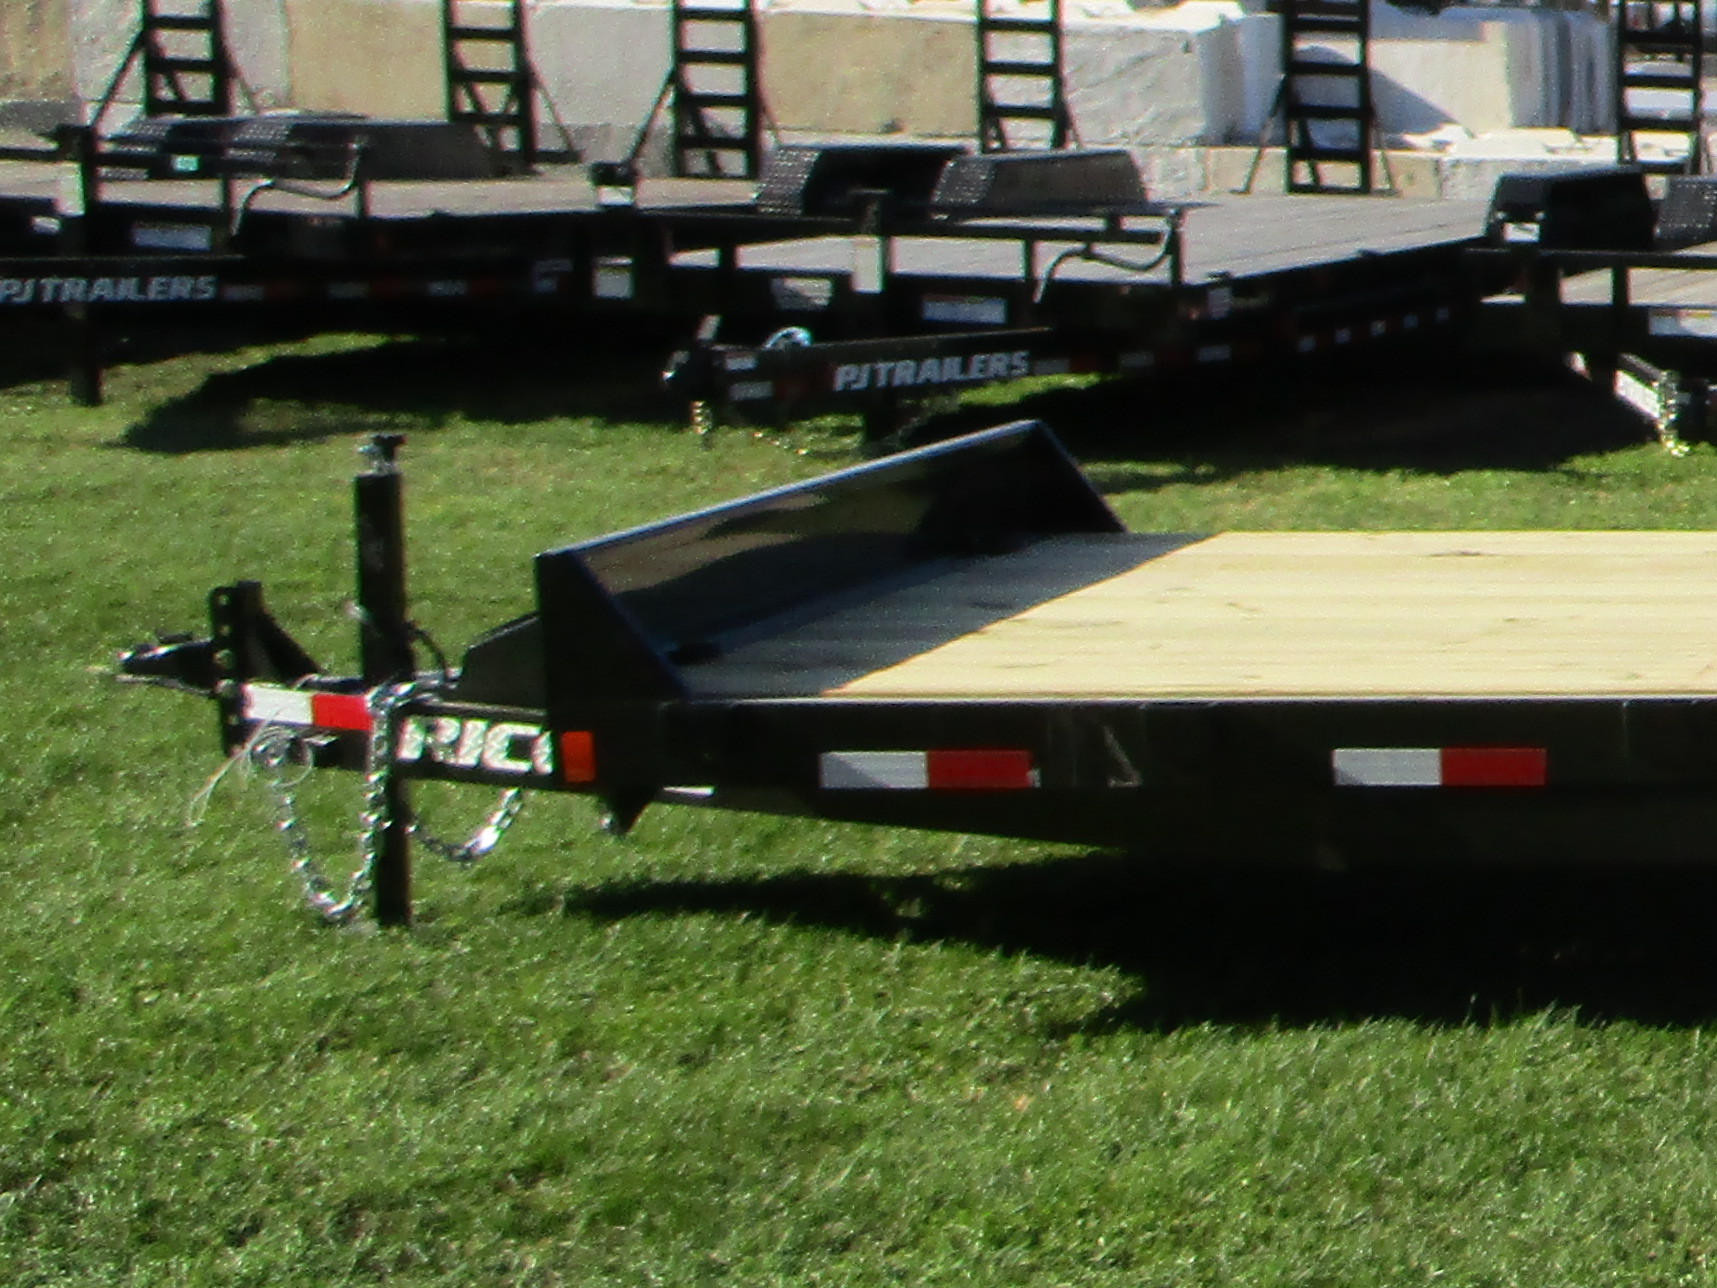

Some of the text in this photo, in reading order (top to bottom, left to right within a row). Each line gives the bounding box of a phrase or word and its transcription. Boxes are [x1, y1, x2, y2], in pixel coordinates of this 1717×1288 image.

[0, 275, 217, 304] PJ TRAILERS
[833, 350, 1030, 392] PJ TRAILERS
